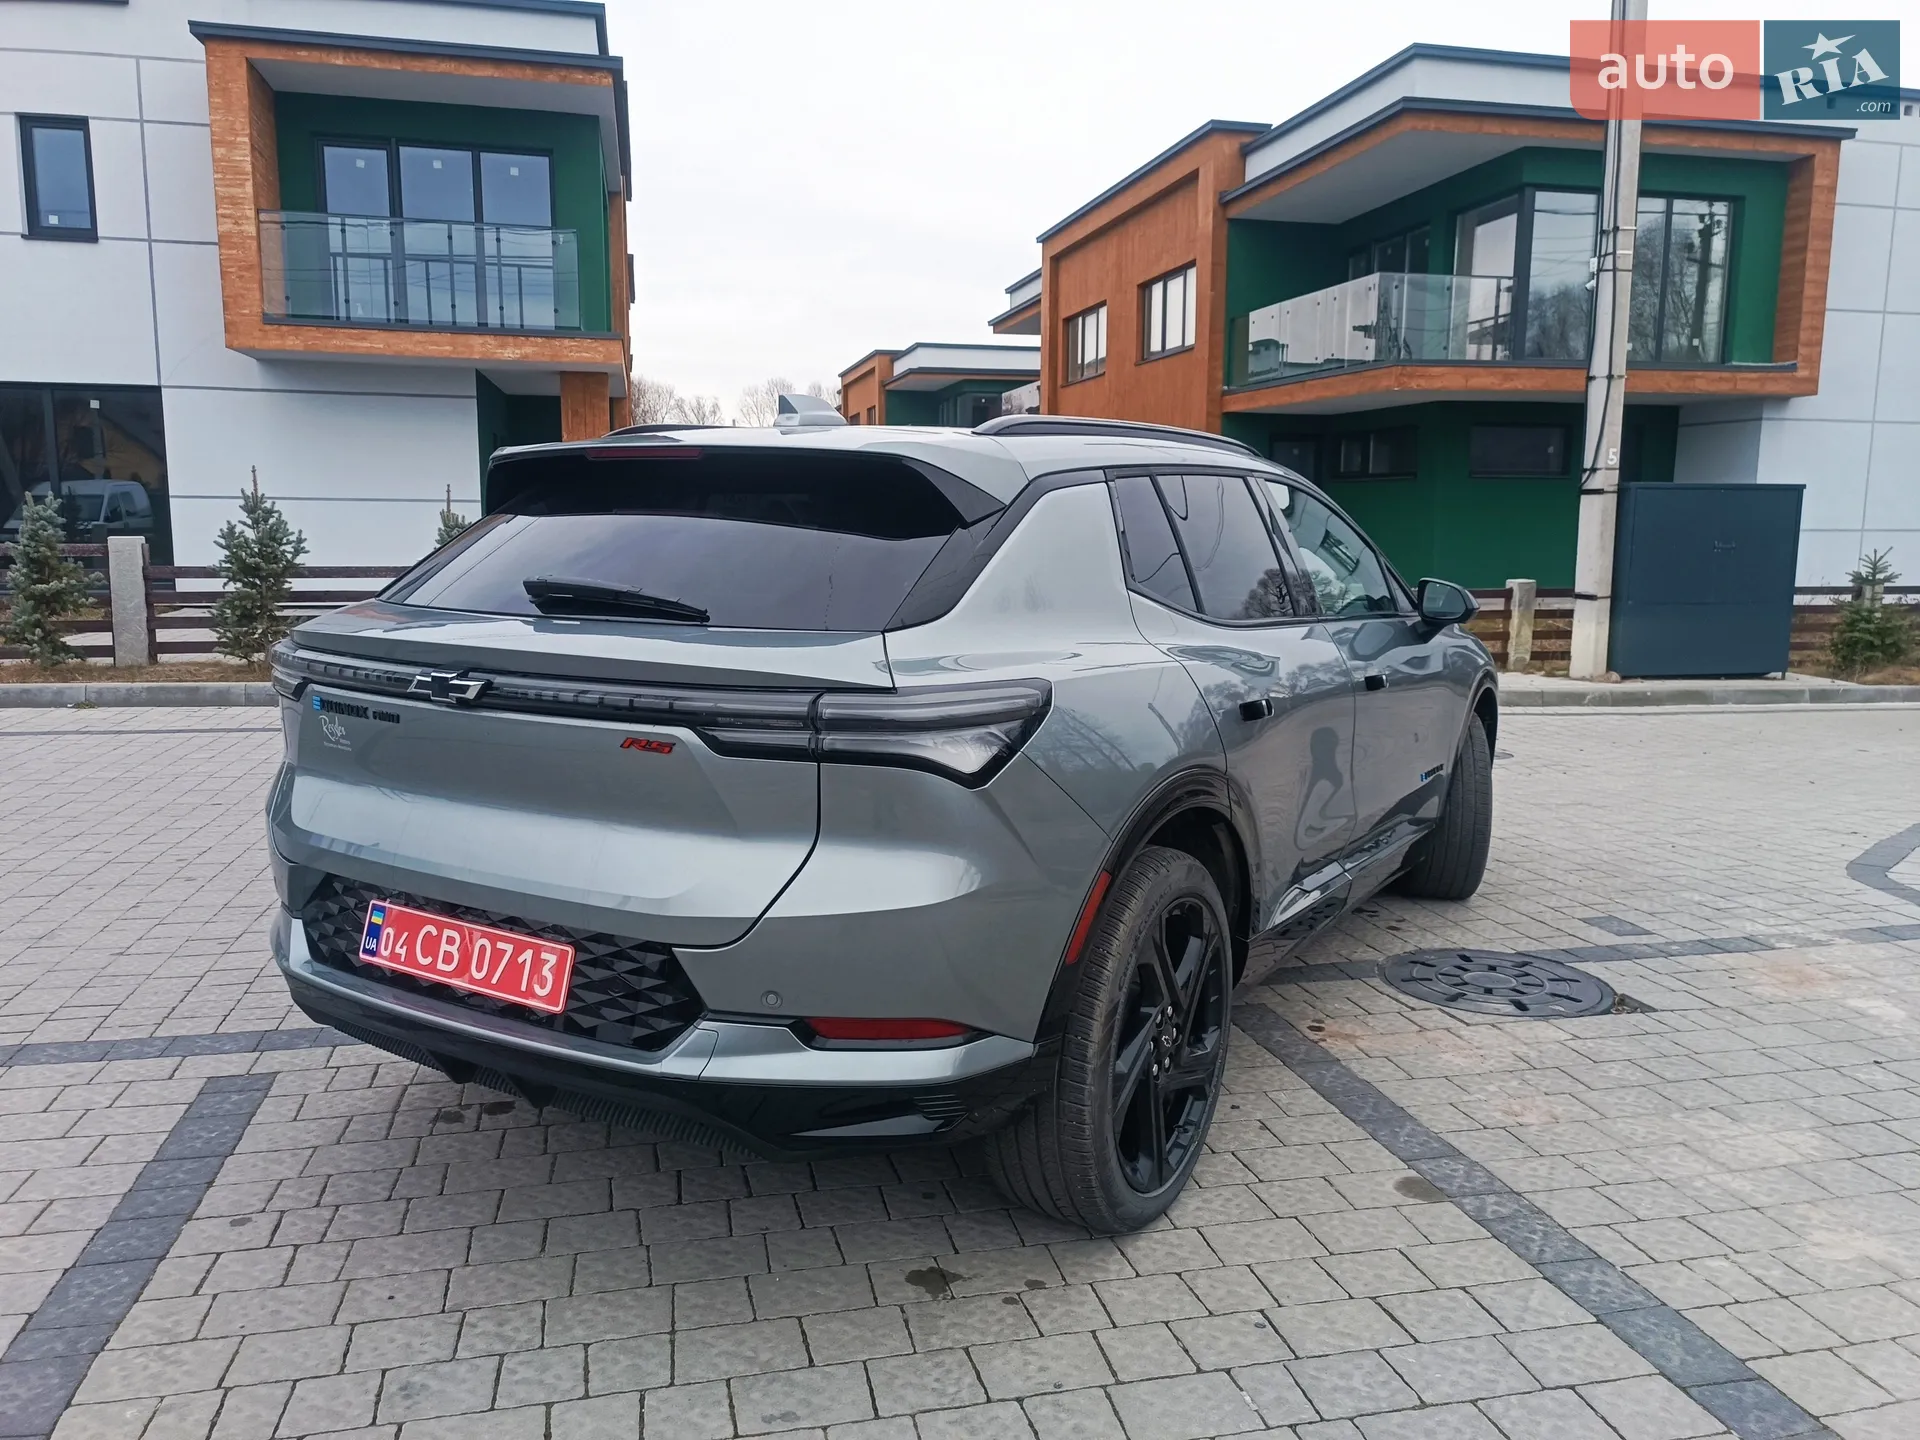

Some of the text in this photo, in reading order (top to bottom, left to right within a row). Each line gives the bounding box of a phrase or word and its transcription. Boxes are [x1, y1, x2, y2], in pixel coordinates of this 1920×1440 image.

[1607, 447, 1618, 465] 5
[620, 737, 676, 754] RS
[365, 936, 377, 952] UA
[380, 924, 557, 997] 04 CB 0713
